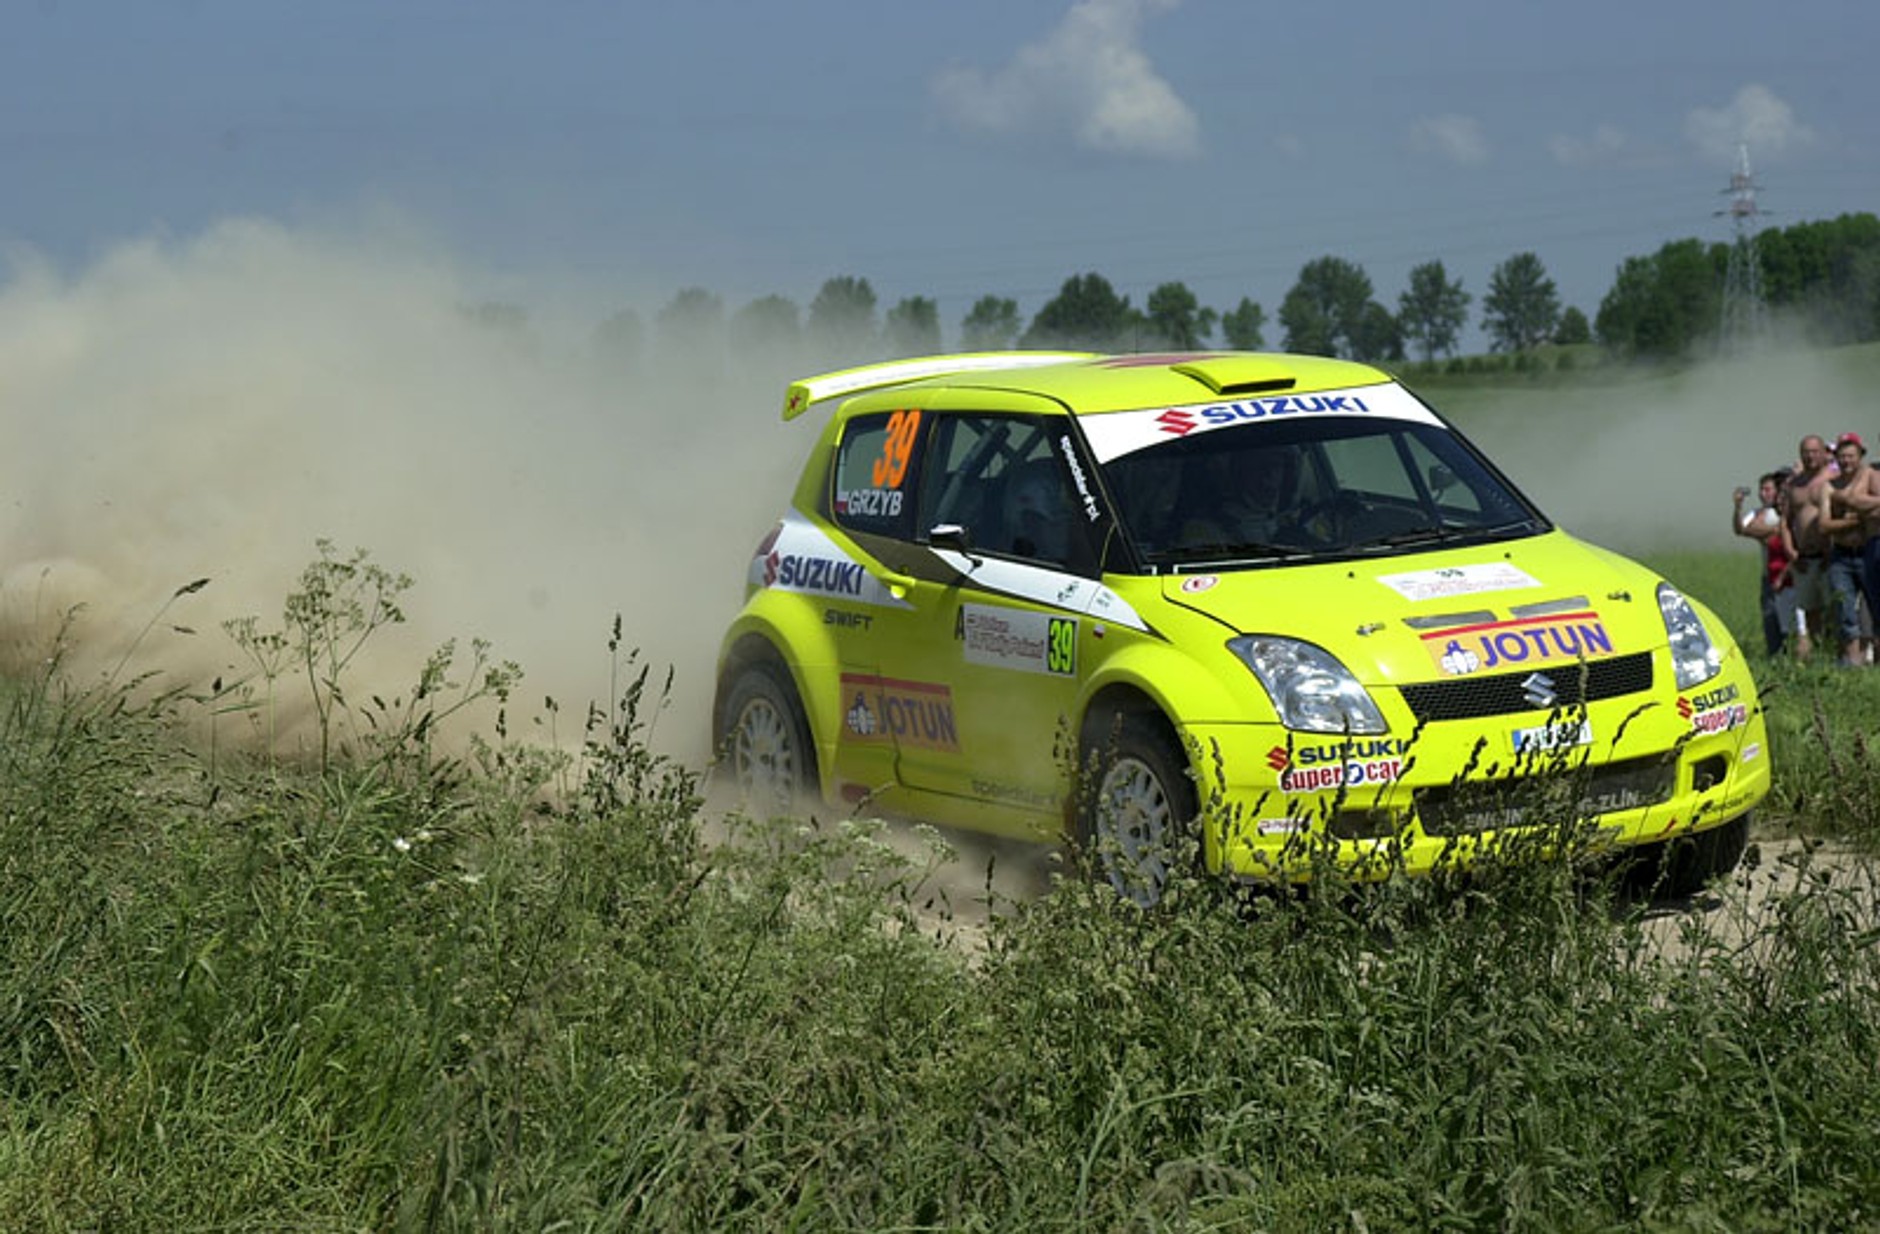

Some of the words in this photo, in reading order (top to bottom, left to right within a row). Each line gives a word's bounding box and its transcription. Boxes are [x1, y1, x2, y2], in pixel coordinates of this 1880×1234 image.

[1201, 397, 1369, 424] SUZUKI
[874, 409, 921, 488] 39
[848, 490, 903, 516] GRZYB
[780, 556, 865, 595] SUZUKI
[824, 609, 873, 630] SWIFT
[1050, 620, 1072, 672] 39
[1480, 623, 1613, 667] JOTUN
[876, 694, 959, 744] JOTUN
[1299, 739, 1404, 764] SUZUKI
